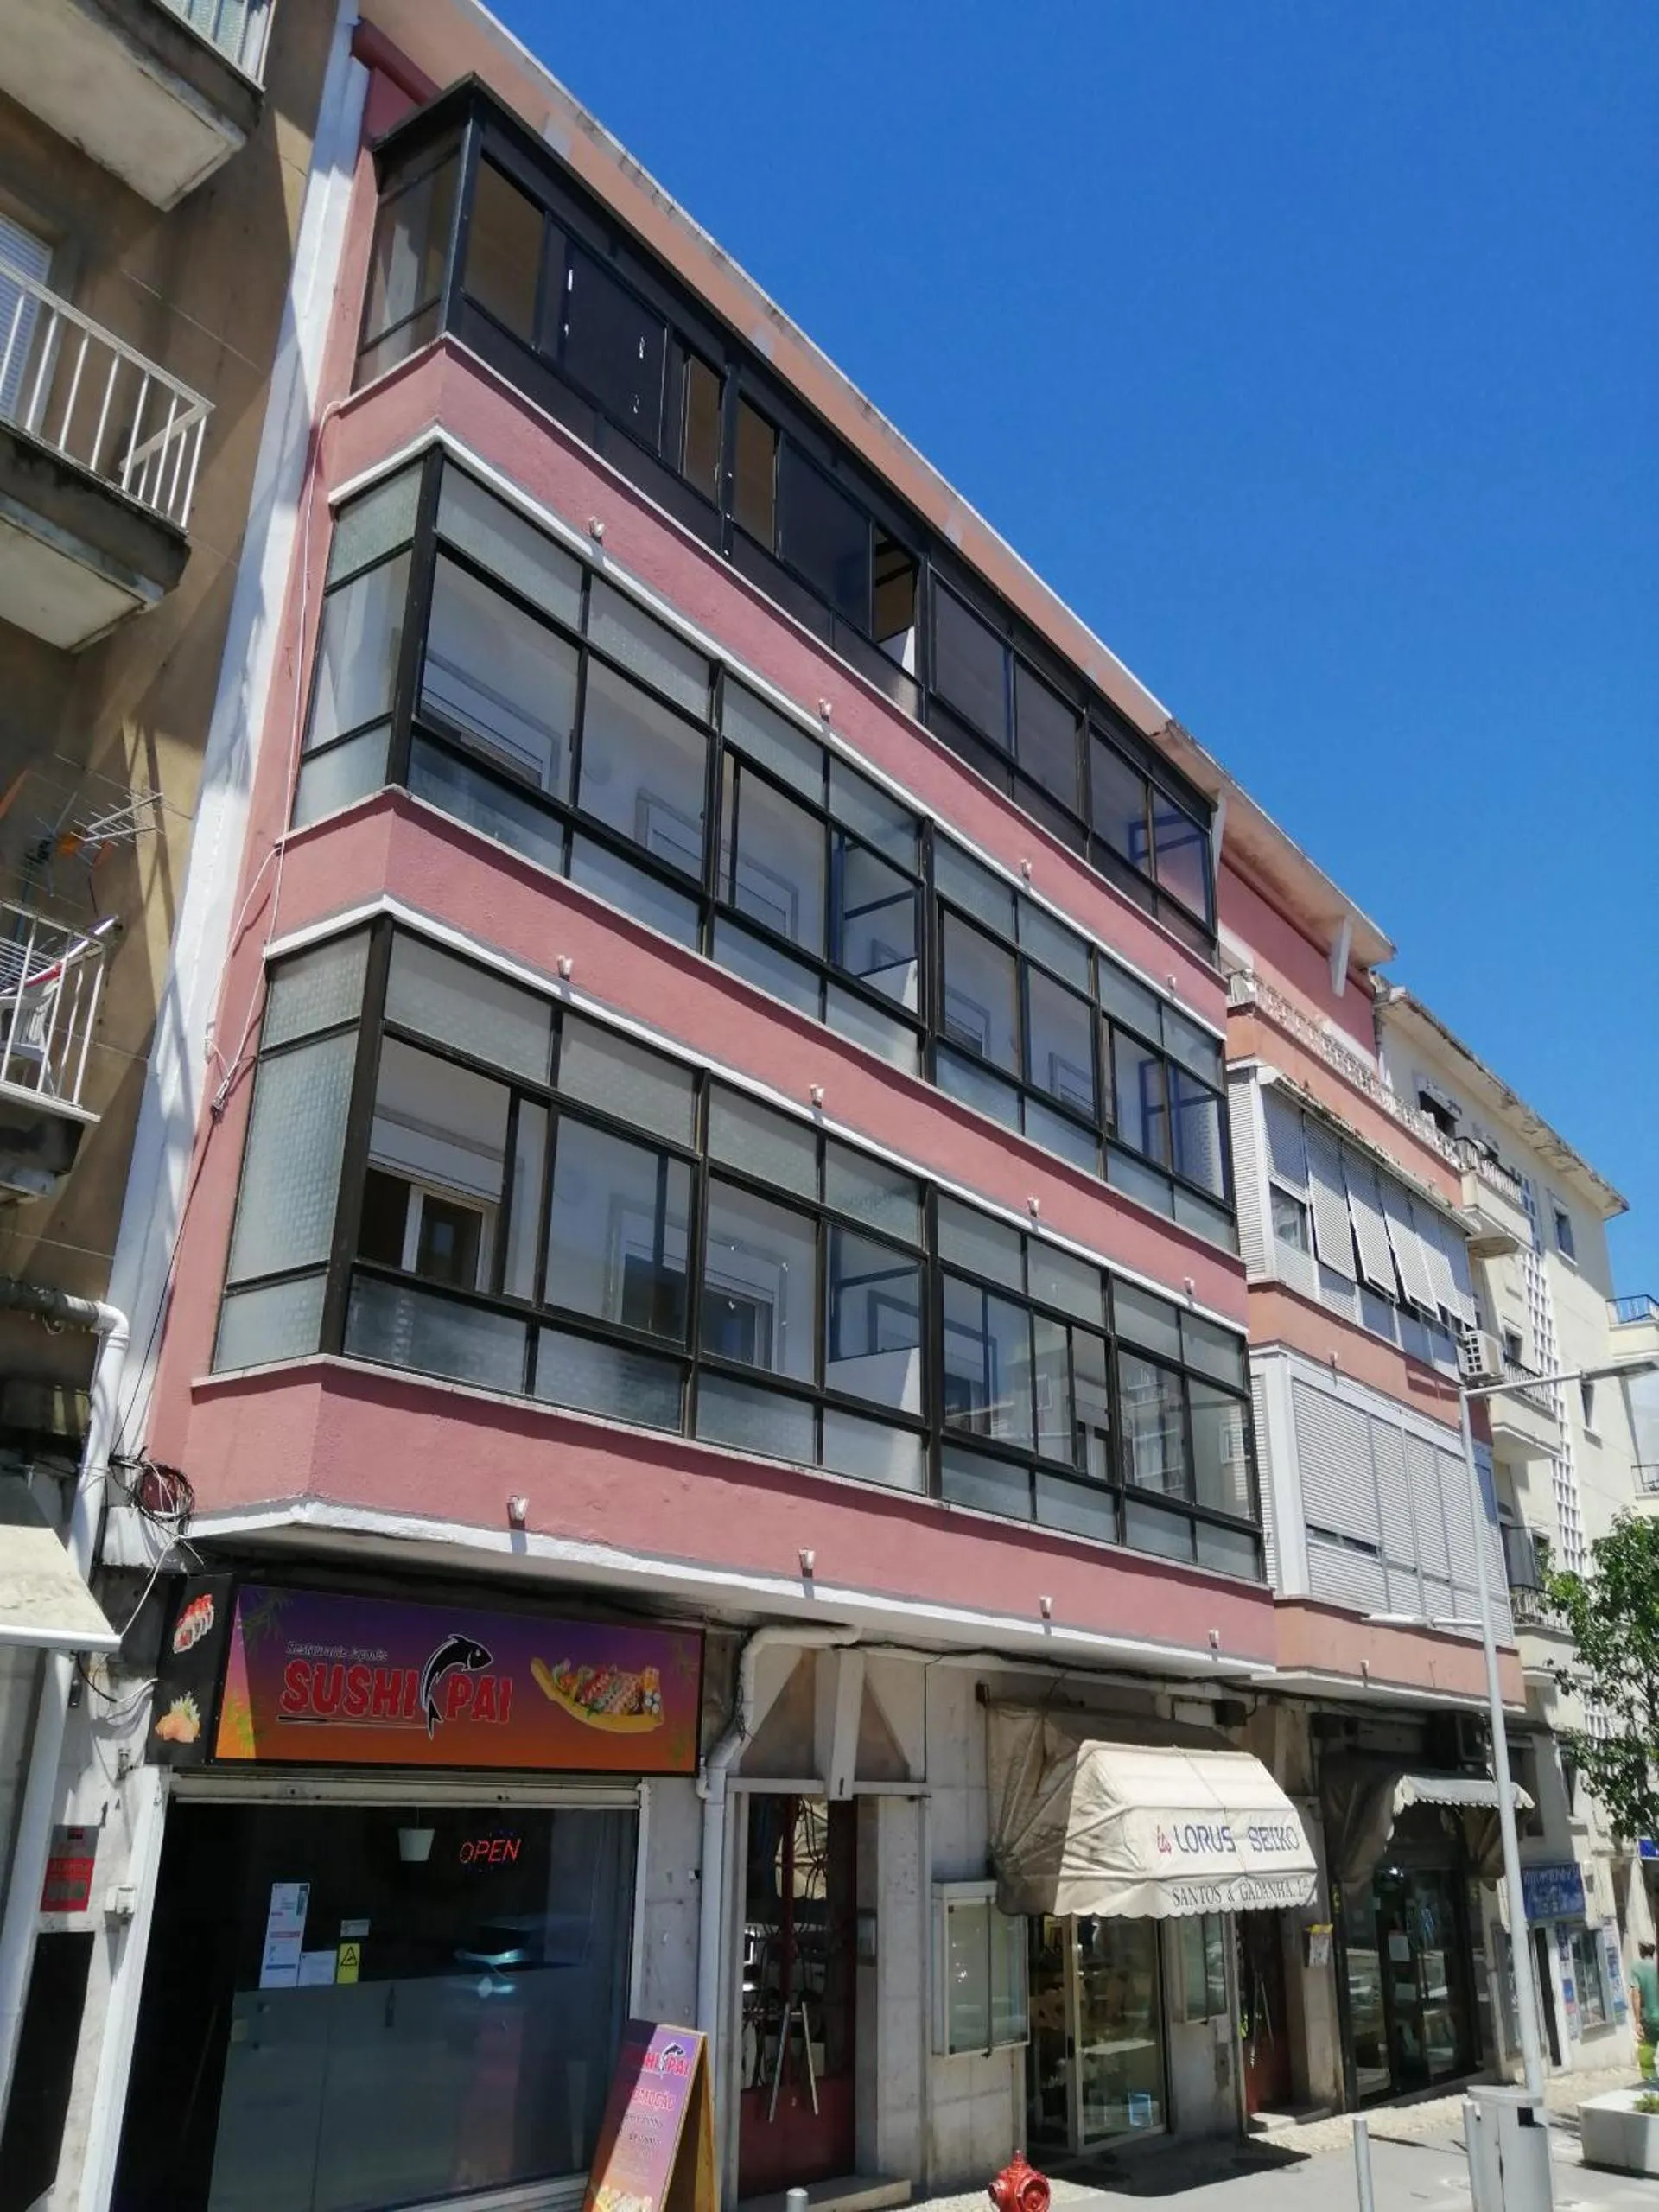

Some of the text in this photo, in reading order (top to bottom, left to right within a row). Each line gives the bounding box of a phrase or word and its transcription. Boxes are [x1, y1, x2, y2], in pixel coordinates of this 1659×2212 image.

[280, 1658, 512, 1724] SUSHI PAI
[459, 1838, 522, 1864] OPEN
[1173, 1824, 1300, 1853] LORUS SEIKO
[1171, 1884, 1223, 1906] SANTOS
[1227, 1887, 1236, 1903] &
